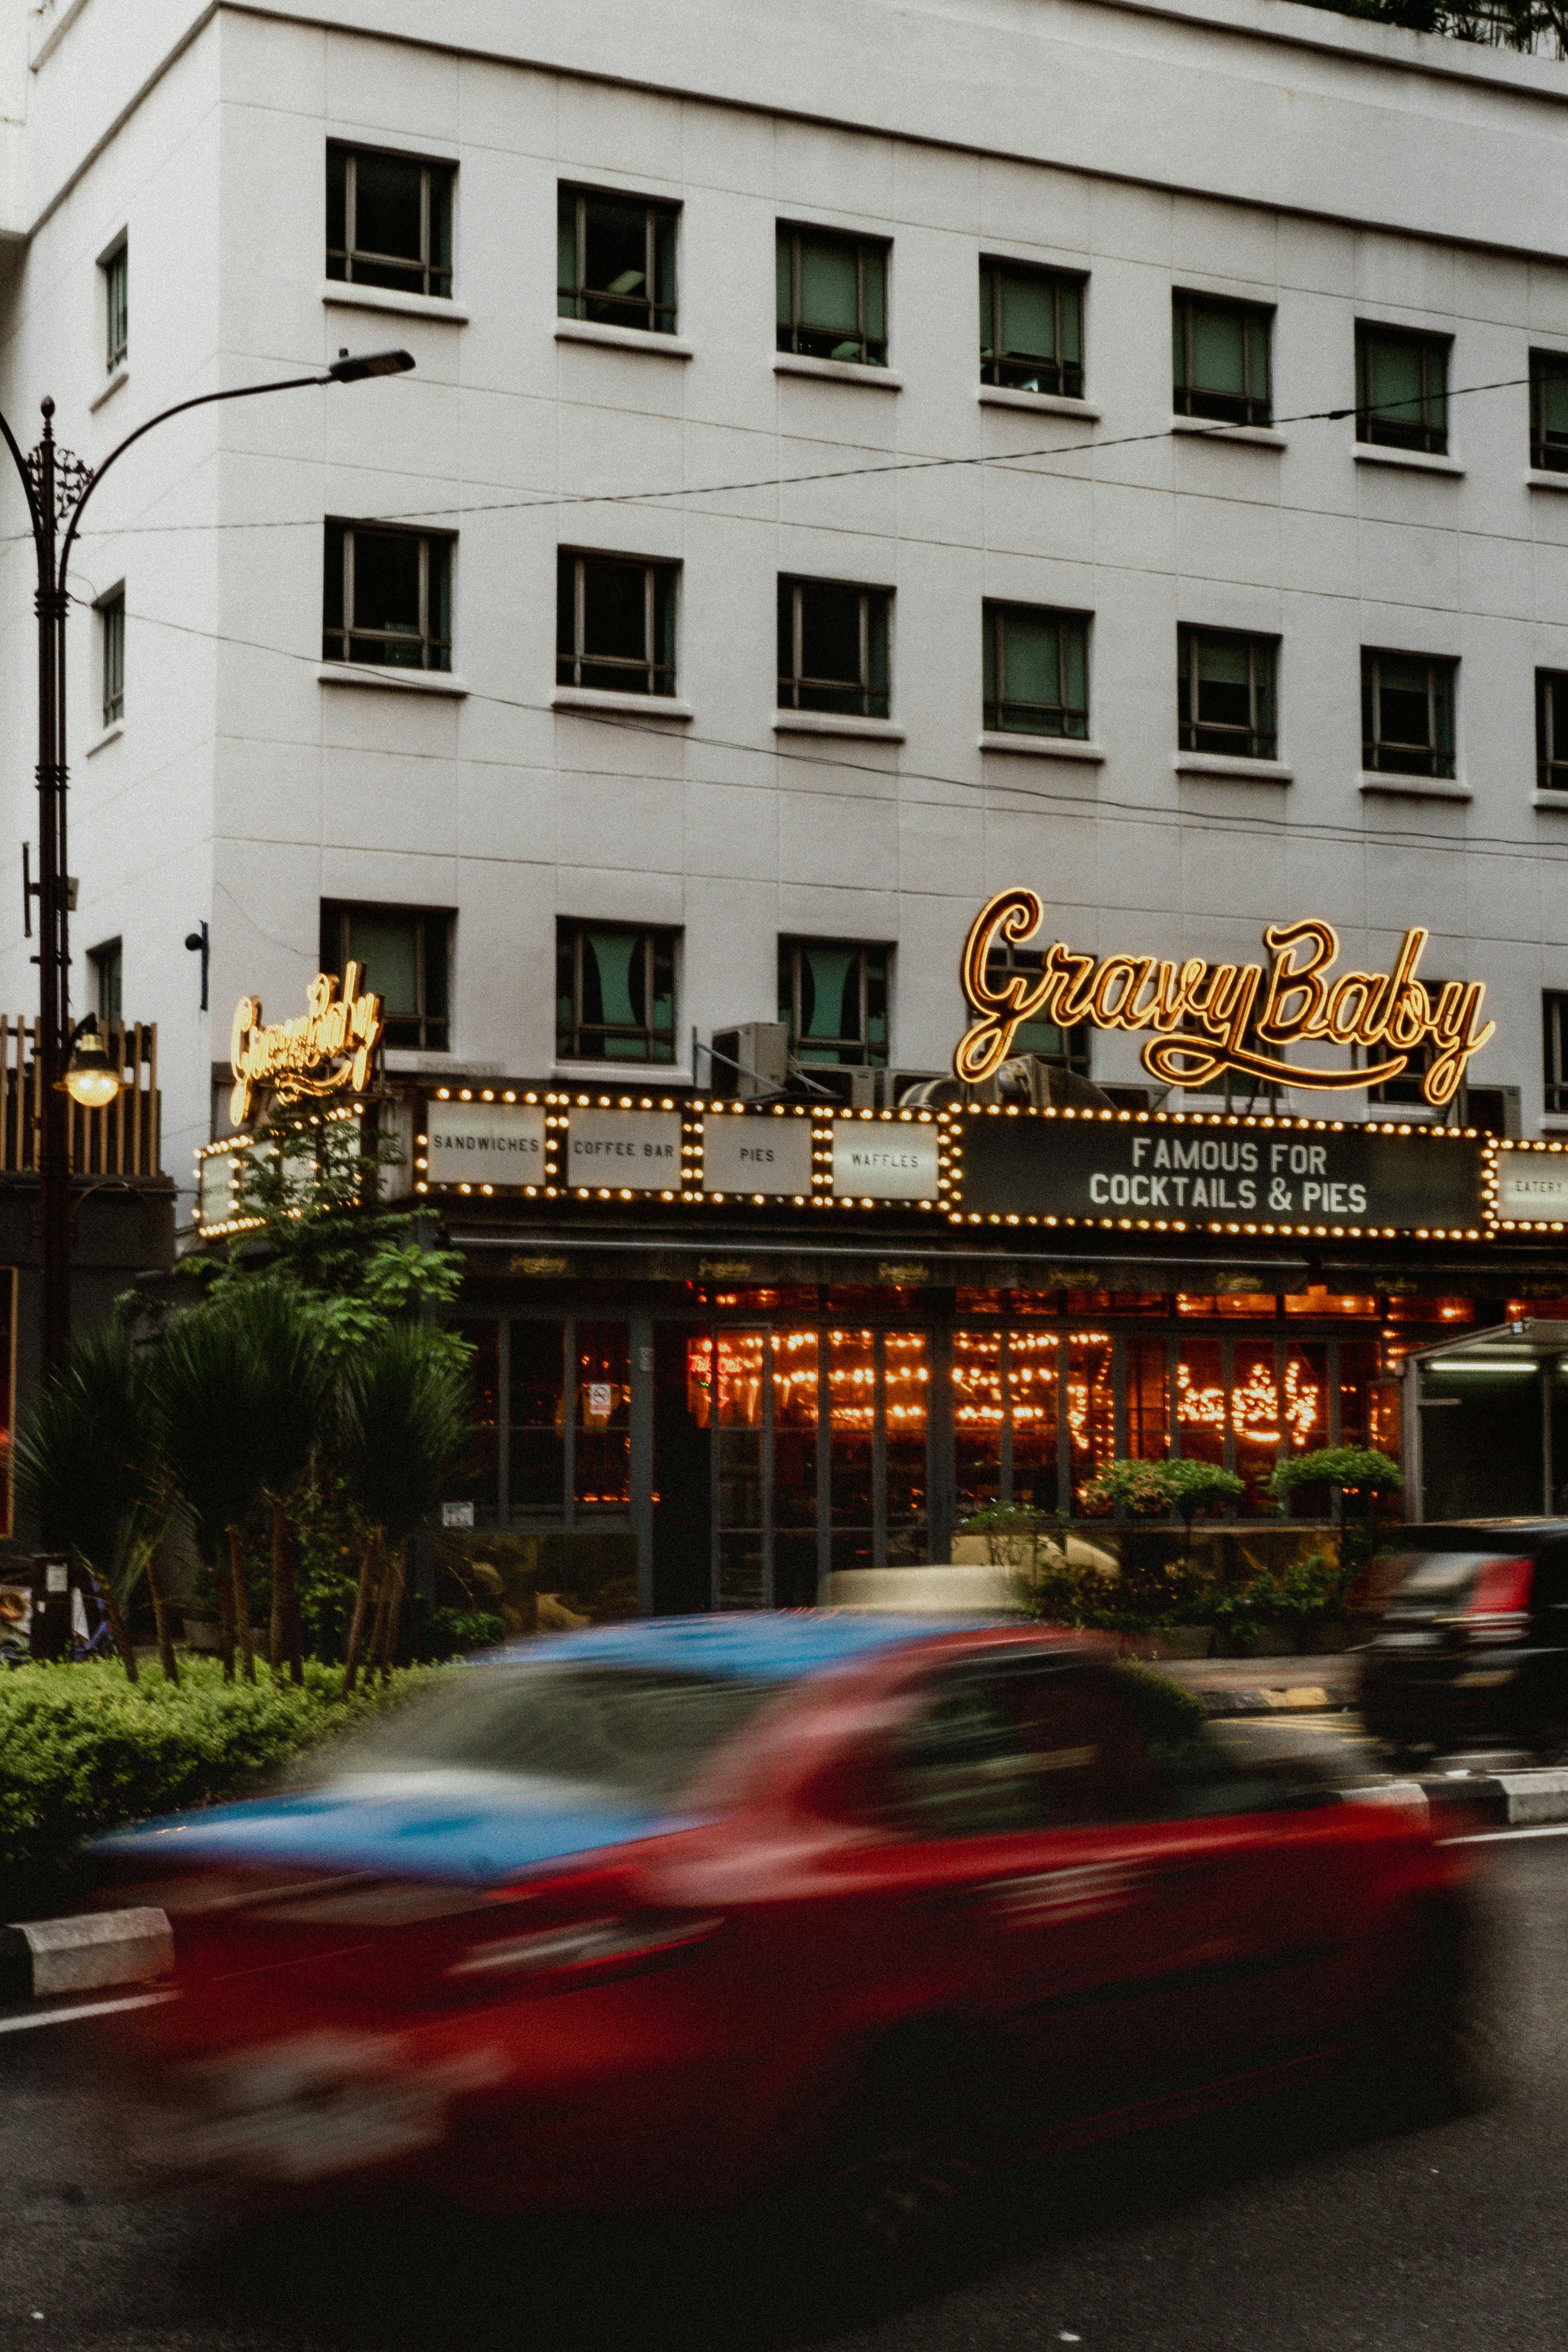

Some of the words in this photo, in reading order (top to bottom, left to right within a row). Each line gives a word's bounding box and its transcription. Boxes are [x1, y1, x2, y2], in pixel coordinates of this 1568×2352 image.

[956, 886, 1407, 1089] Gravy
[1257, 918, 1496, 1105] Baby
[434, 1134, 539, 1152] SANDWICHES
[574, 1141, 635, 1157] COFFEE
[644, 1143, 673, 1158] BAR
[740, 1148, 774, 1162] PIES
[852, 1153, 918, 1168] WAFFLES
[1132, 1137, 1259, 1172] FAMOUS
[1270, 1144, 1327, 1174] FOR
[1089, 1173, 1257, 1209] COCKTAILS
[1268, 1177, 1293, 1211] &
[1303, 1181, 1367, 1213] PIES
